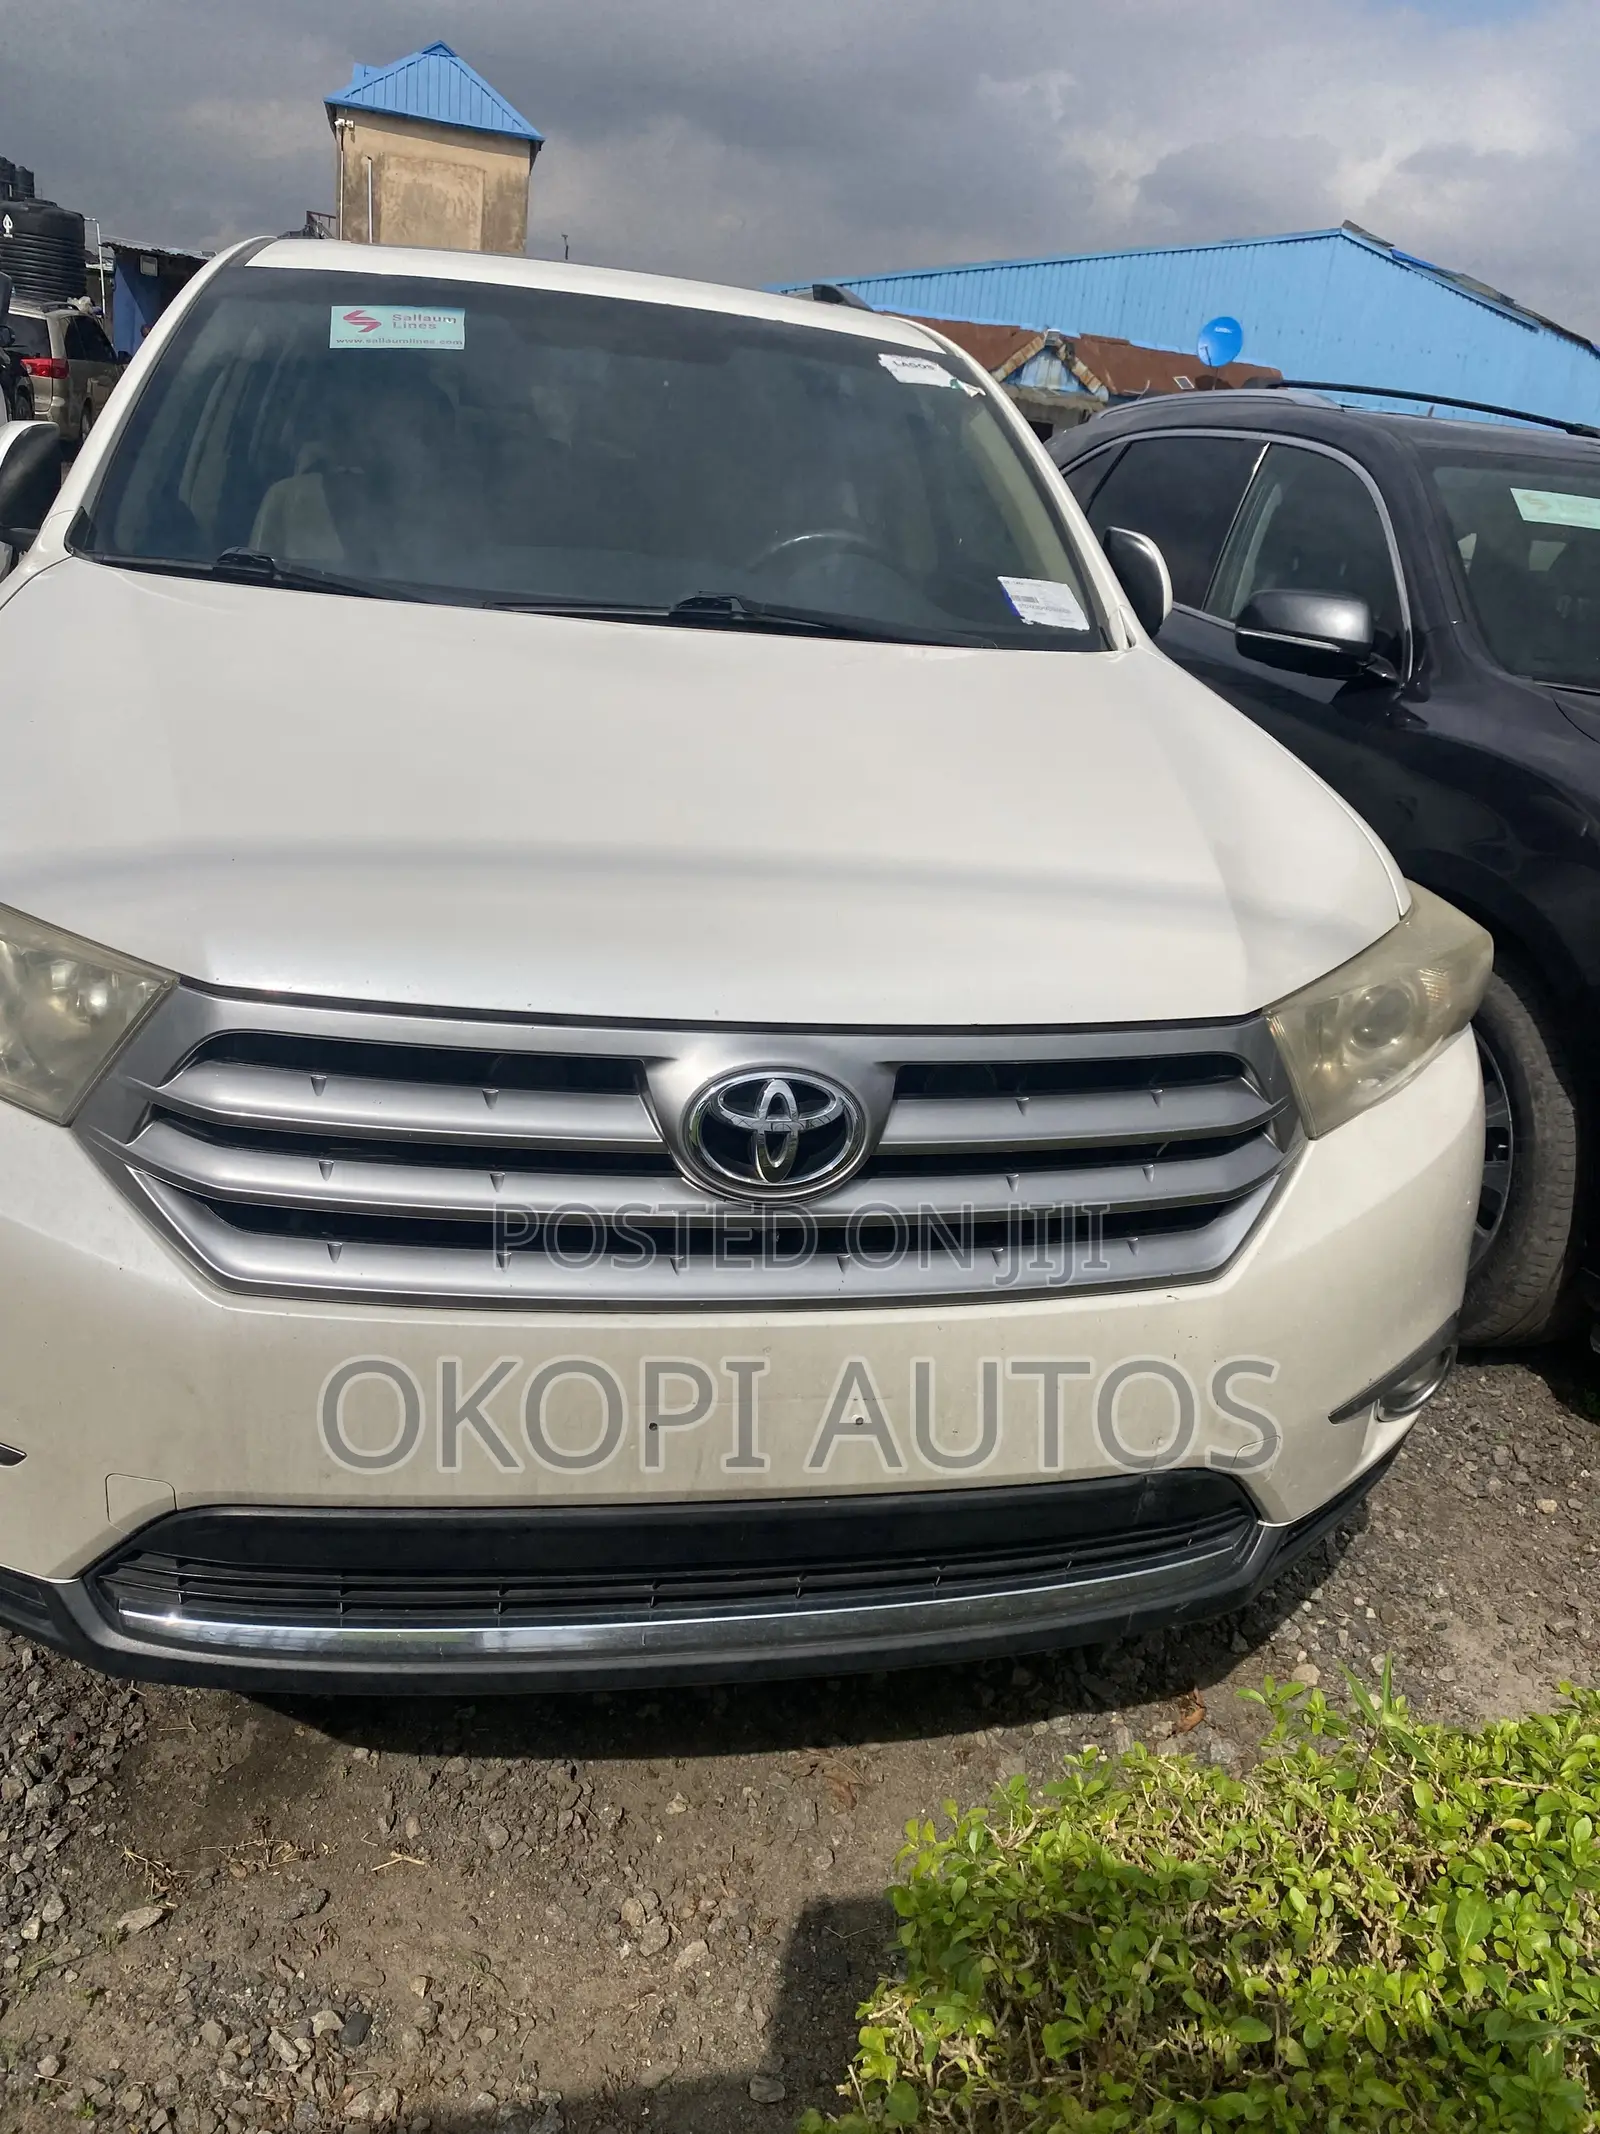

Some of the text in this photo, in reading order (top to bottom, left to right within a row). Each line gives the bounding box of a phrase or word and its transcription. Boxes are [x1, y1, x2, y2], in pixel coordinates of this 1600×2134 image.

[392, 313, 457, 323] Sallaum
[392, 322, 437, 330] Lines
[335, 337, 463, 346] www.sallaumlines.com
